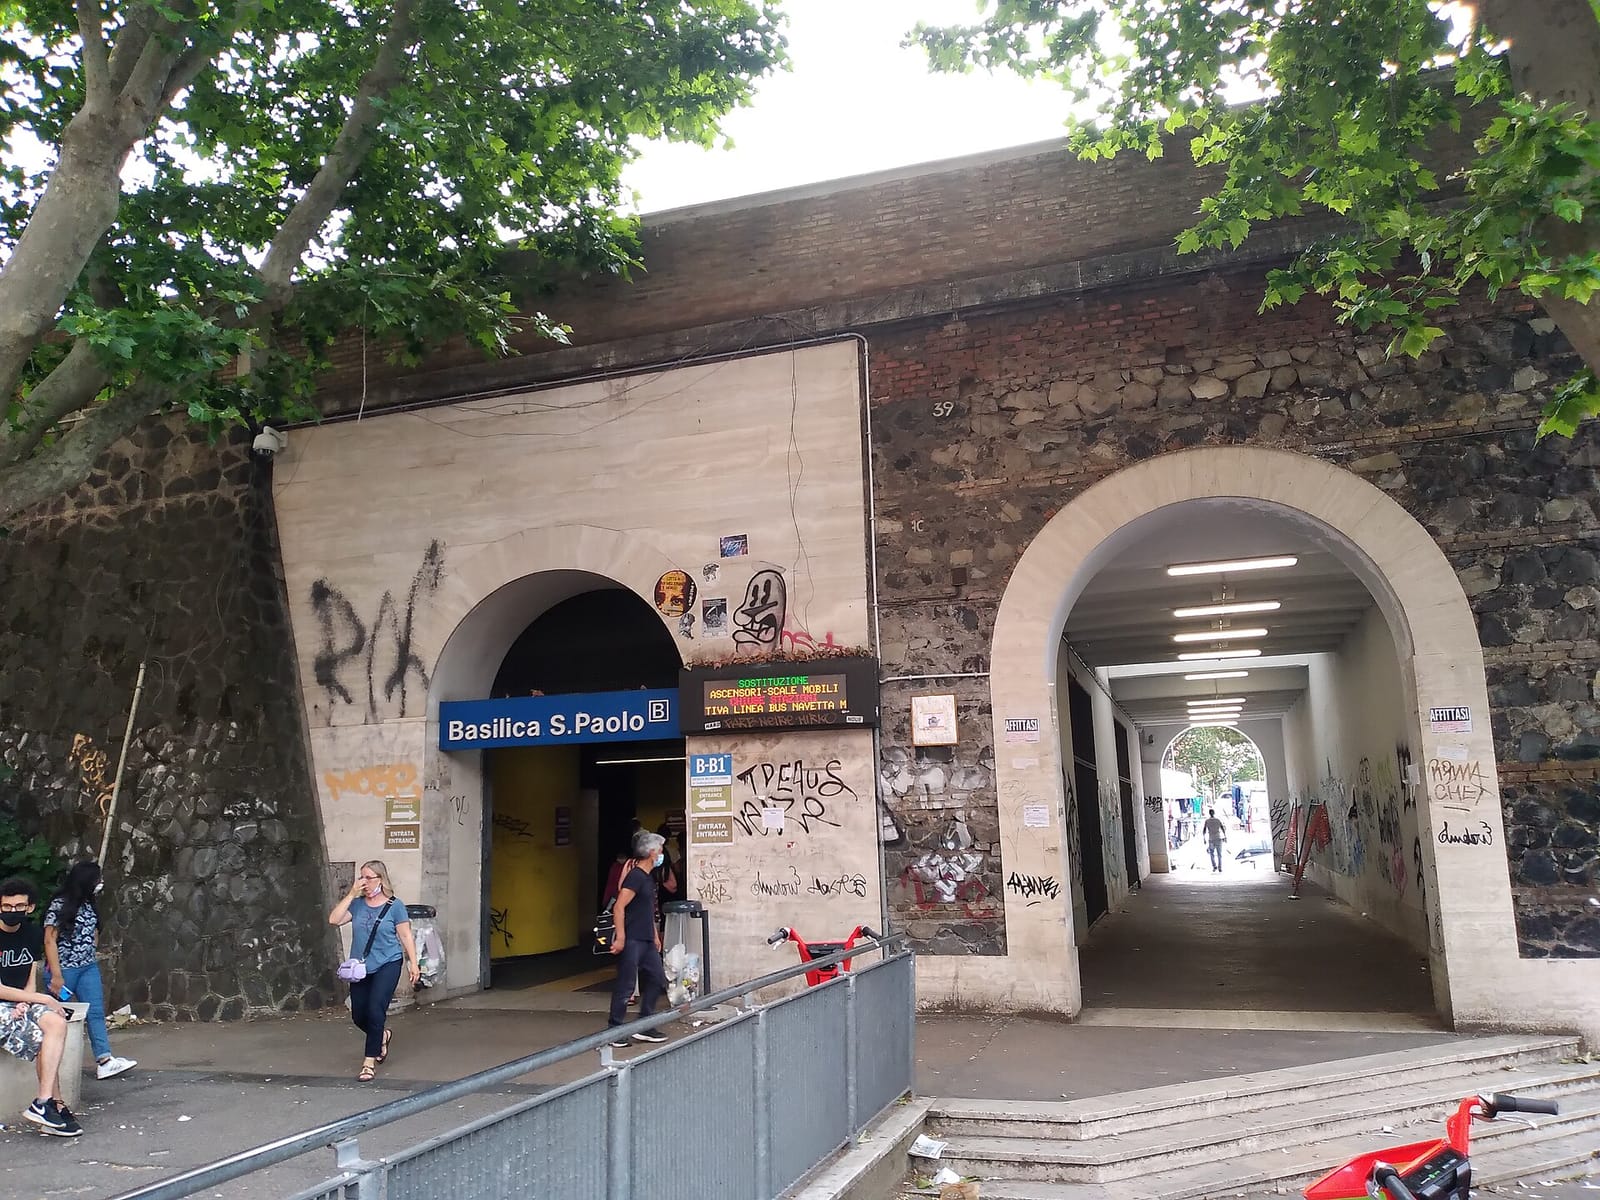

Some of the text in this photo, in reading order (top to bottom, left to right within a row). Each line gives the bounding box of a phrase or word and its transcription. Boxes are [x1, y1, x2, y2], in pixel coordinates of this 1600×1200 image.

[932, 401, 954, 417] 39
[738, 676, 809, 688] SOSTITUZIONE
[710, 684, 838, 699] ASCENSORI-SCALE MOBILI
[705, 706, 729, 716] TIVA
[734, 704, 764, 714] LINEA
[769, 703, 787, 712] BUS
[792, 701, 835, 711] NAVETTA
[1430, 708, 1469, 721] AFFITTASI
[448, 717, 541, 741] Basilica
[550, 711, 645, 736] S.Paolo
[1005, 719, 1038, 731] AFFITTASI
[696, 757, 726, 774] B-B1
[698, 822, 727, 830] ENTRATA
[0, 947, 34, 968] ILA
